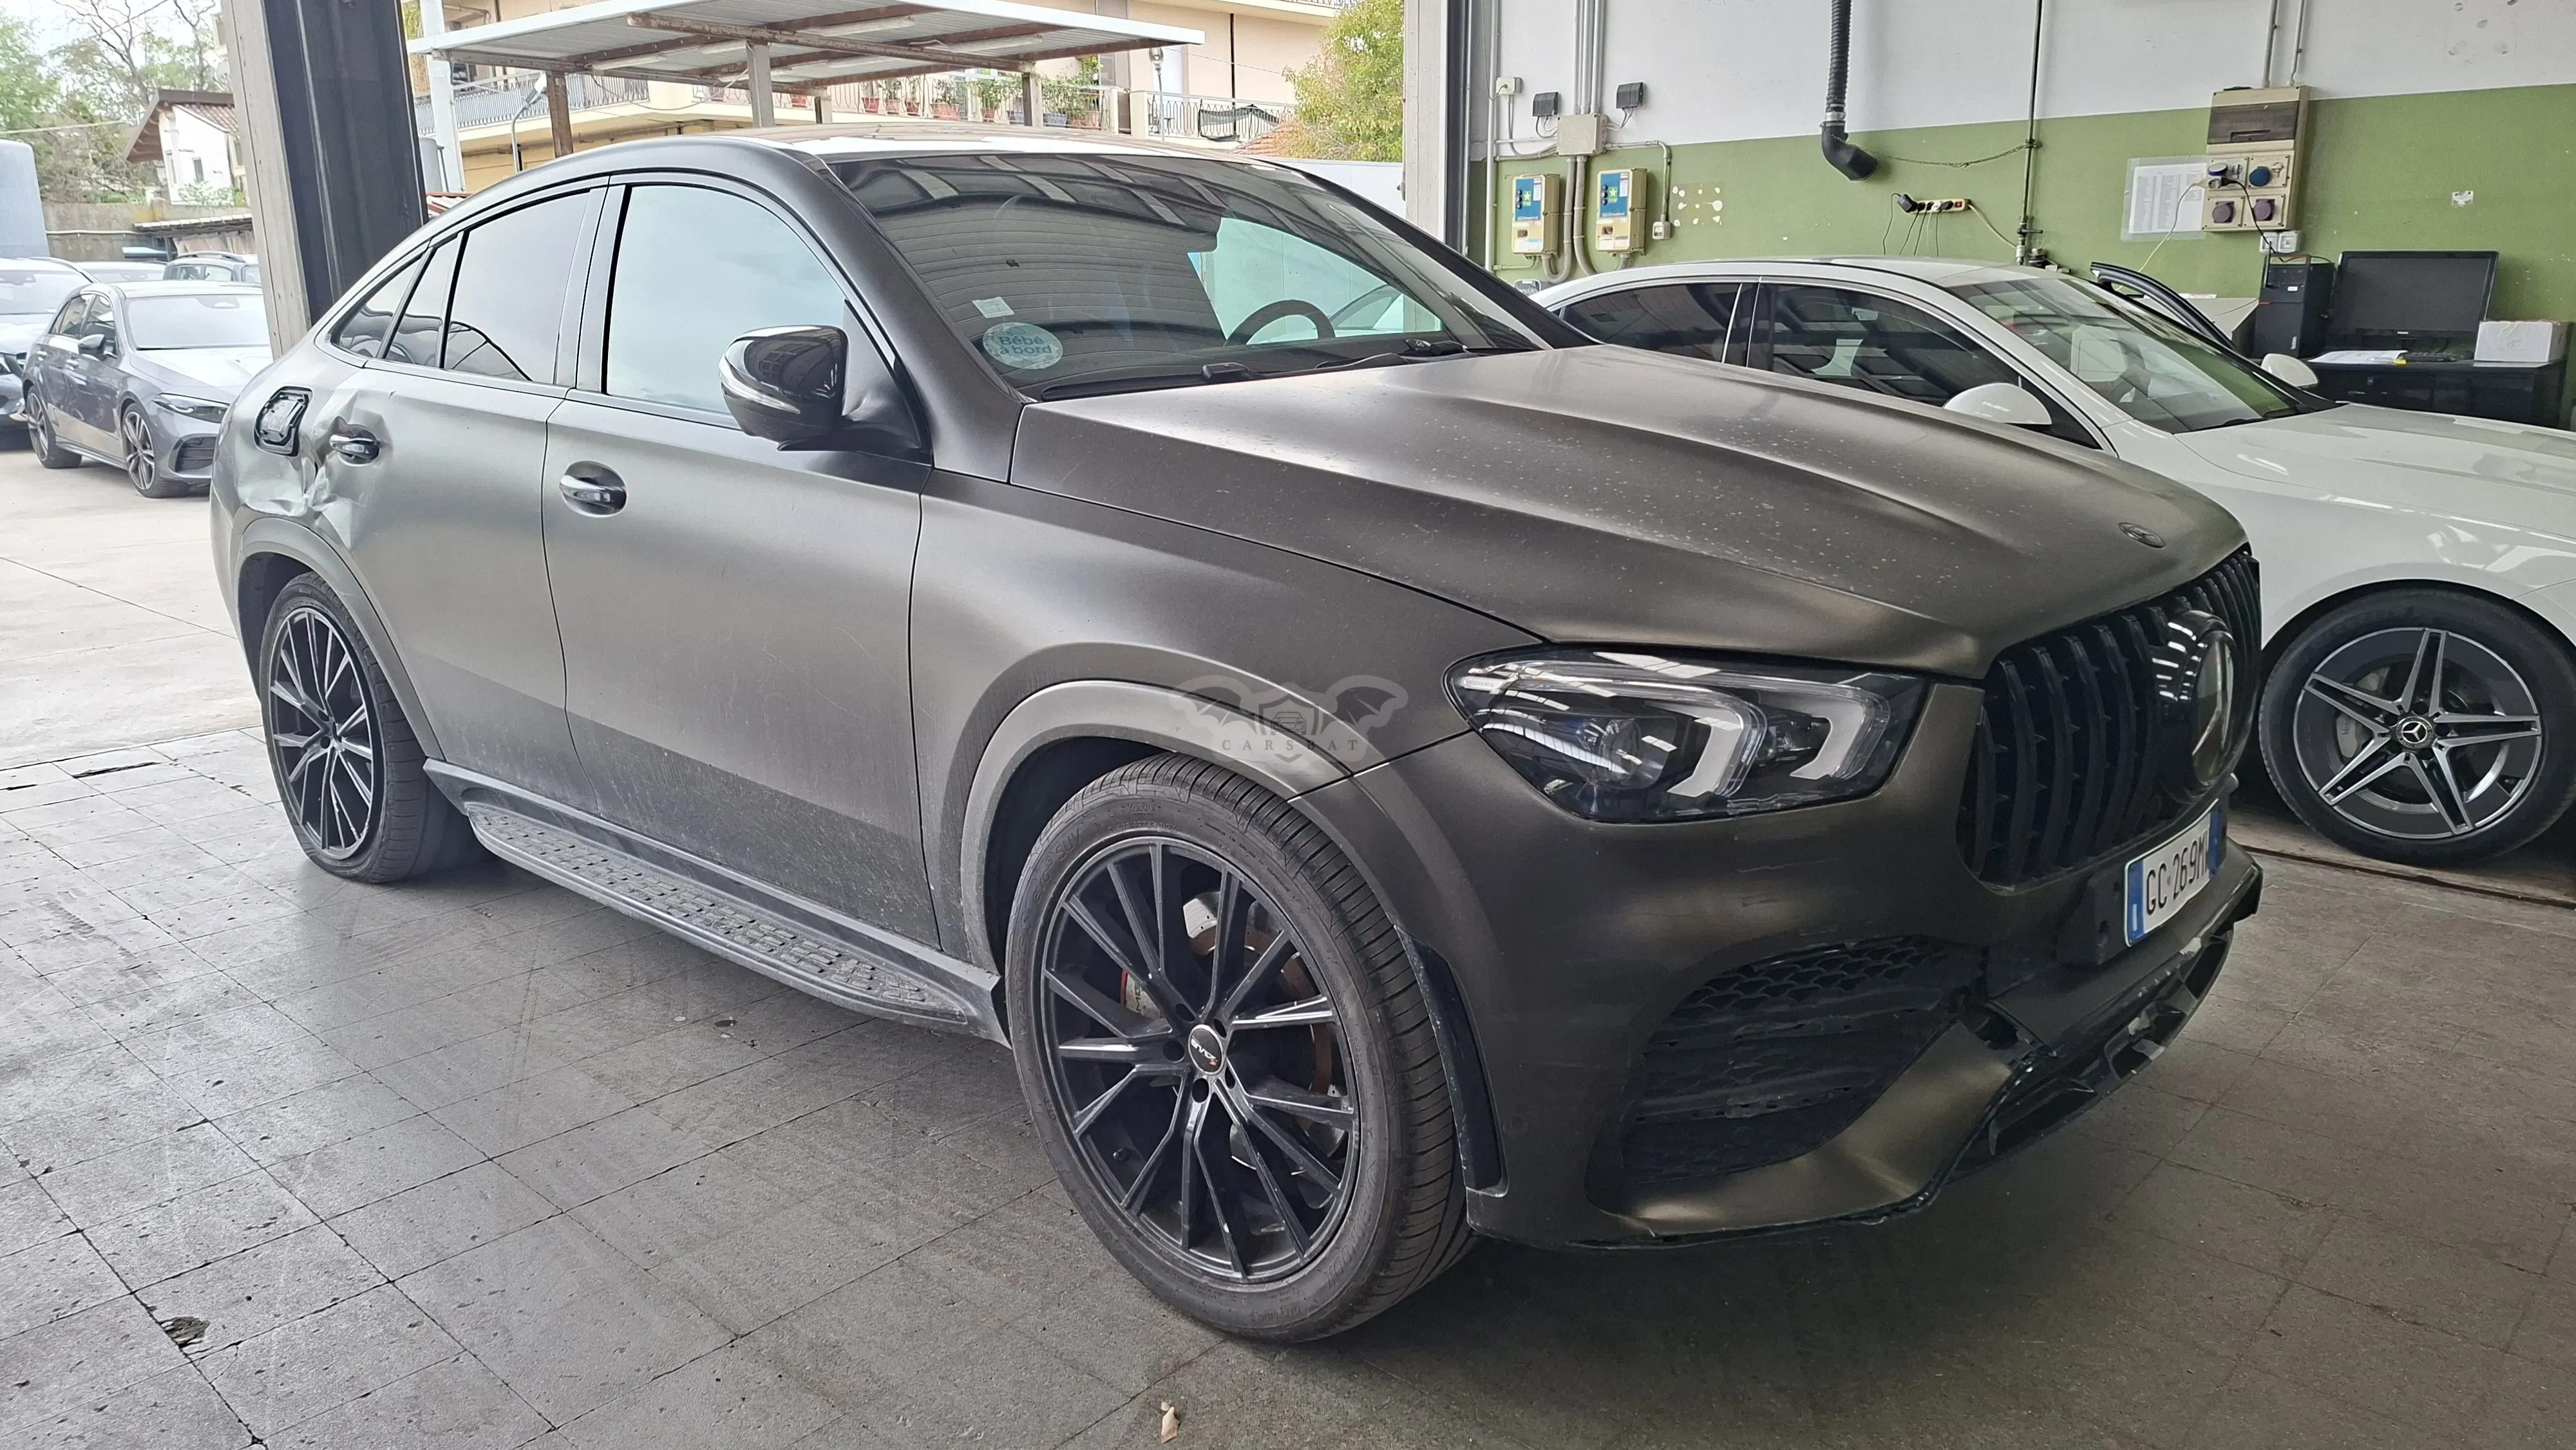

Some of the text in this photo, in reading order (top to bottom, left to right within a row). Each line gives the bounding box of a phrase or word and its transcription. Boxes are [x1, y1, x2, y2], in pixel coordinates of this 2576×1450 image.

[999, 335, 1045, 346] Bébé
[999, 344, 1052, 355] à bord
[2146, 862, 2168, 916] GC
